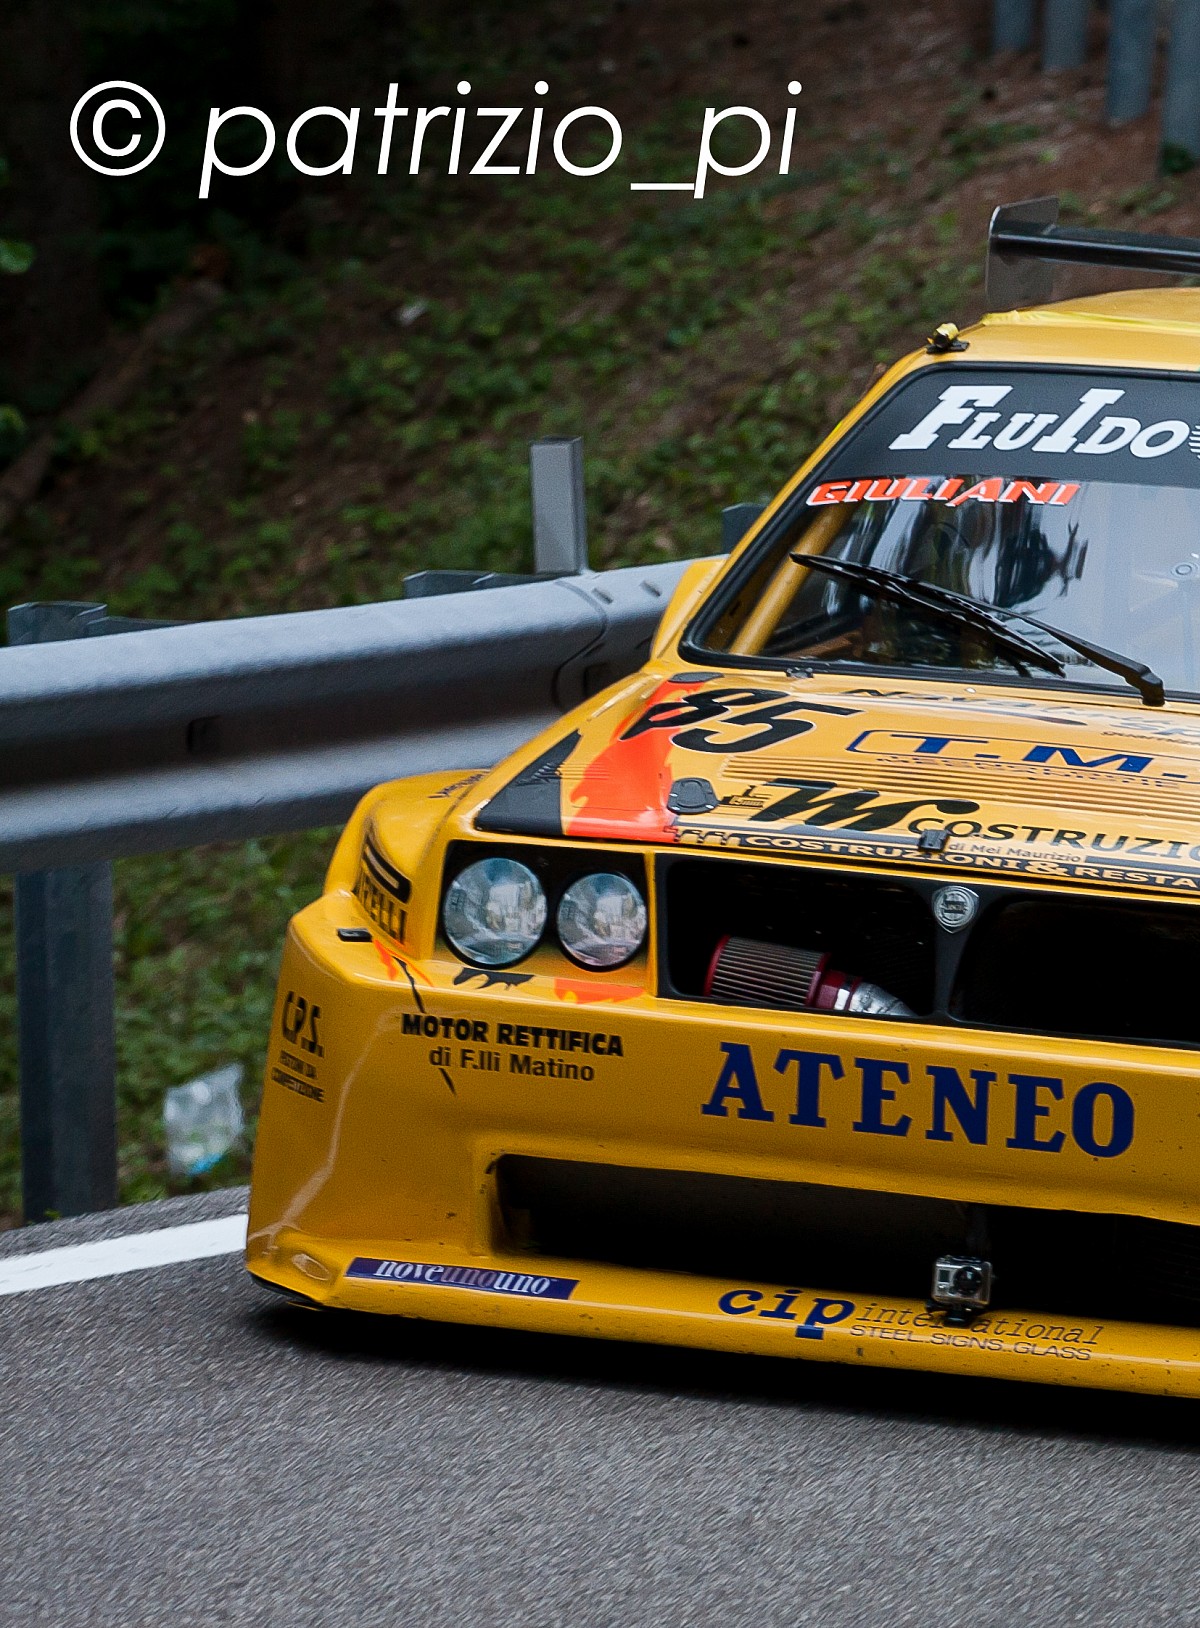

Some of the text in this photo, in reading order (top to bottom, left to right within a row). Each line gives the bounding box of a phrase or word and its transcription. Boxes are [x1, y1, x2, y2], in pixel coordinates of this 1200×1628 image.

[806, 477, 1080, 507] GIULIANI
[640, 687, 868, 754] 85
[746, 836, 1023, 869] COSTRUZIONI
[1025, 860, 1070, 877] &
[950, 842, 1081, 862] di Mei Maurizio
[401, 1013, 624, 1057] MOTOR RETTIFICA
[429, 1046, 450, 1068] di
[510, 1053, 595, 1082] Matino
[701, 1041, 1135, 1158] ATENEO
[373, 1259, 552, 1295] noveunouno
[718, 1289, 1104, 1345] cip interational
